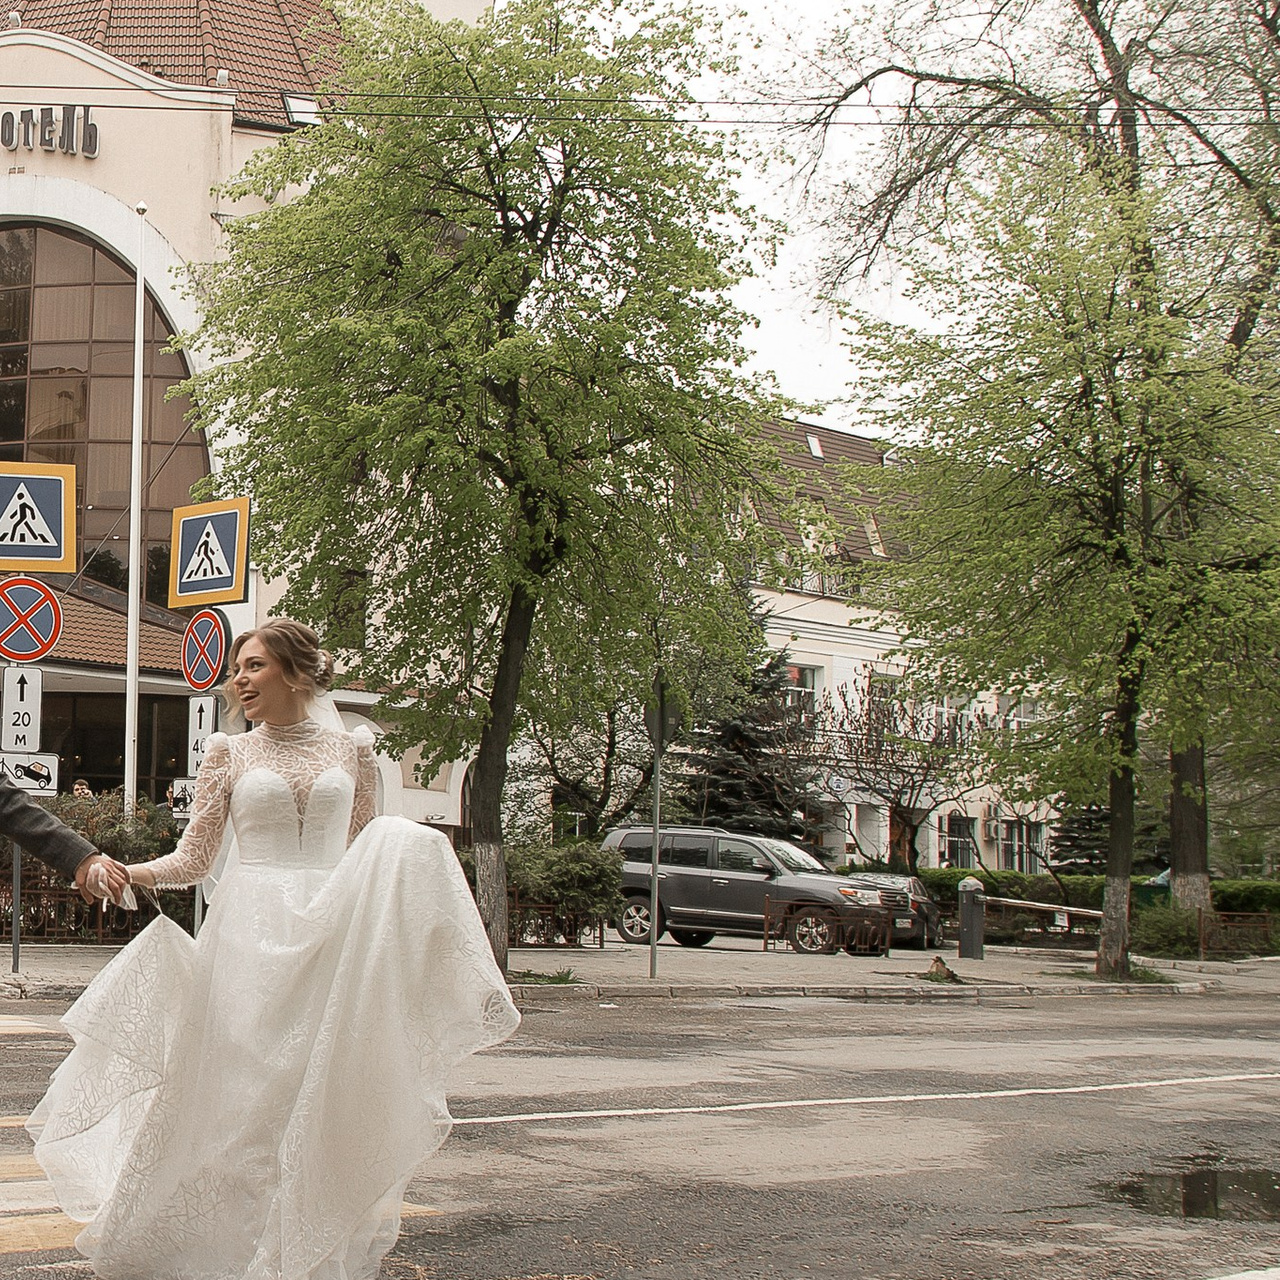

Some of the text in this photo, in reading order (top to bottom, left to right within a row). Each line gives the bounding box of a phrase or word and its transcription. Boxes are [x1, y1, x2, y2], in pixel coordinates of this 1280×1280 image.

[0, 104, 100, 159] ОТЕЛЬ
[11, 711, 31, 727] 20
[14, 734, 27, 746] М
